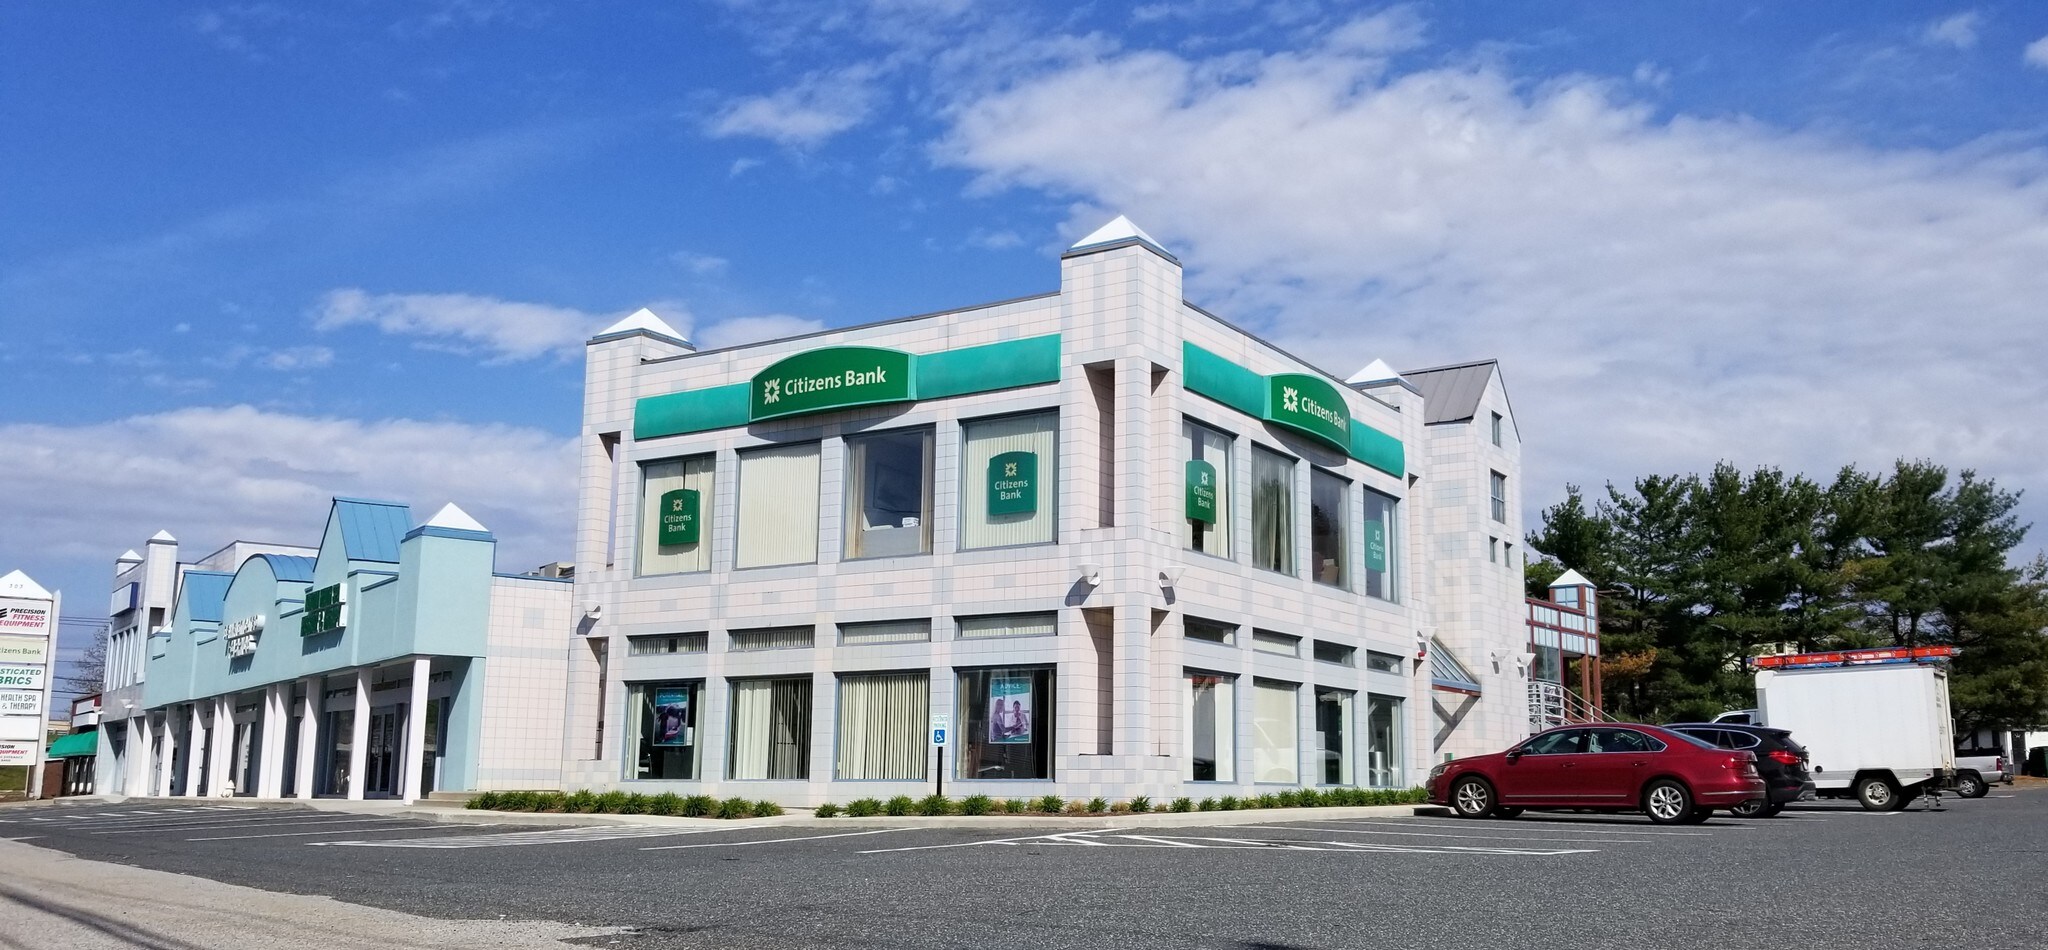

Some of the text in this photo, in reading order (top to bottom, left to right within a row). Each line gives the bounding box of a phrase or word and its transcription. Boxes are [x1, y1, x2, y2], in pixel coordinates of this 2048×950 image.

[785, 366, 886, 396] Citizens Bank
[1301, 397, 1347, 431] Citizens Bank
[994, 480, 1028, 490] Citizens
[1000, 489, 1022, 500] Bank
[1193, 485, 1213, 499] Citizens
[664, 514, 692, 523] Citizens
[668, 523, 686, 532] Bank
[0, 620, 45, 628] EQUIPMENT
[22, 647, 41, 655] Bank
[24, 694, 36, 702] SPA
[10, 702, 37, 710] THERAPY
